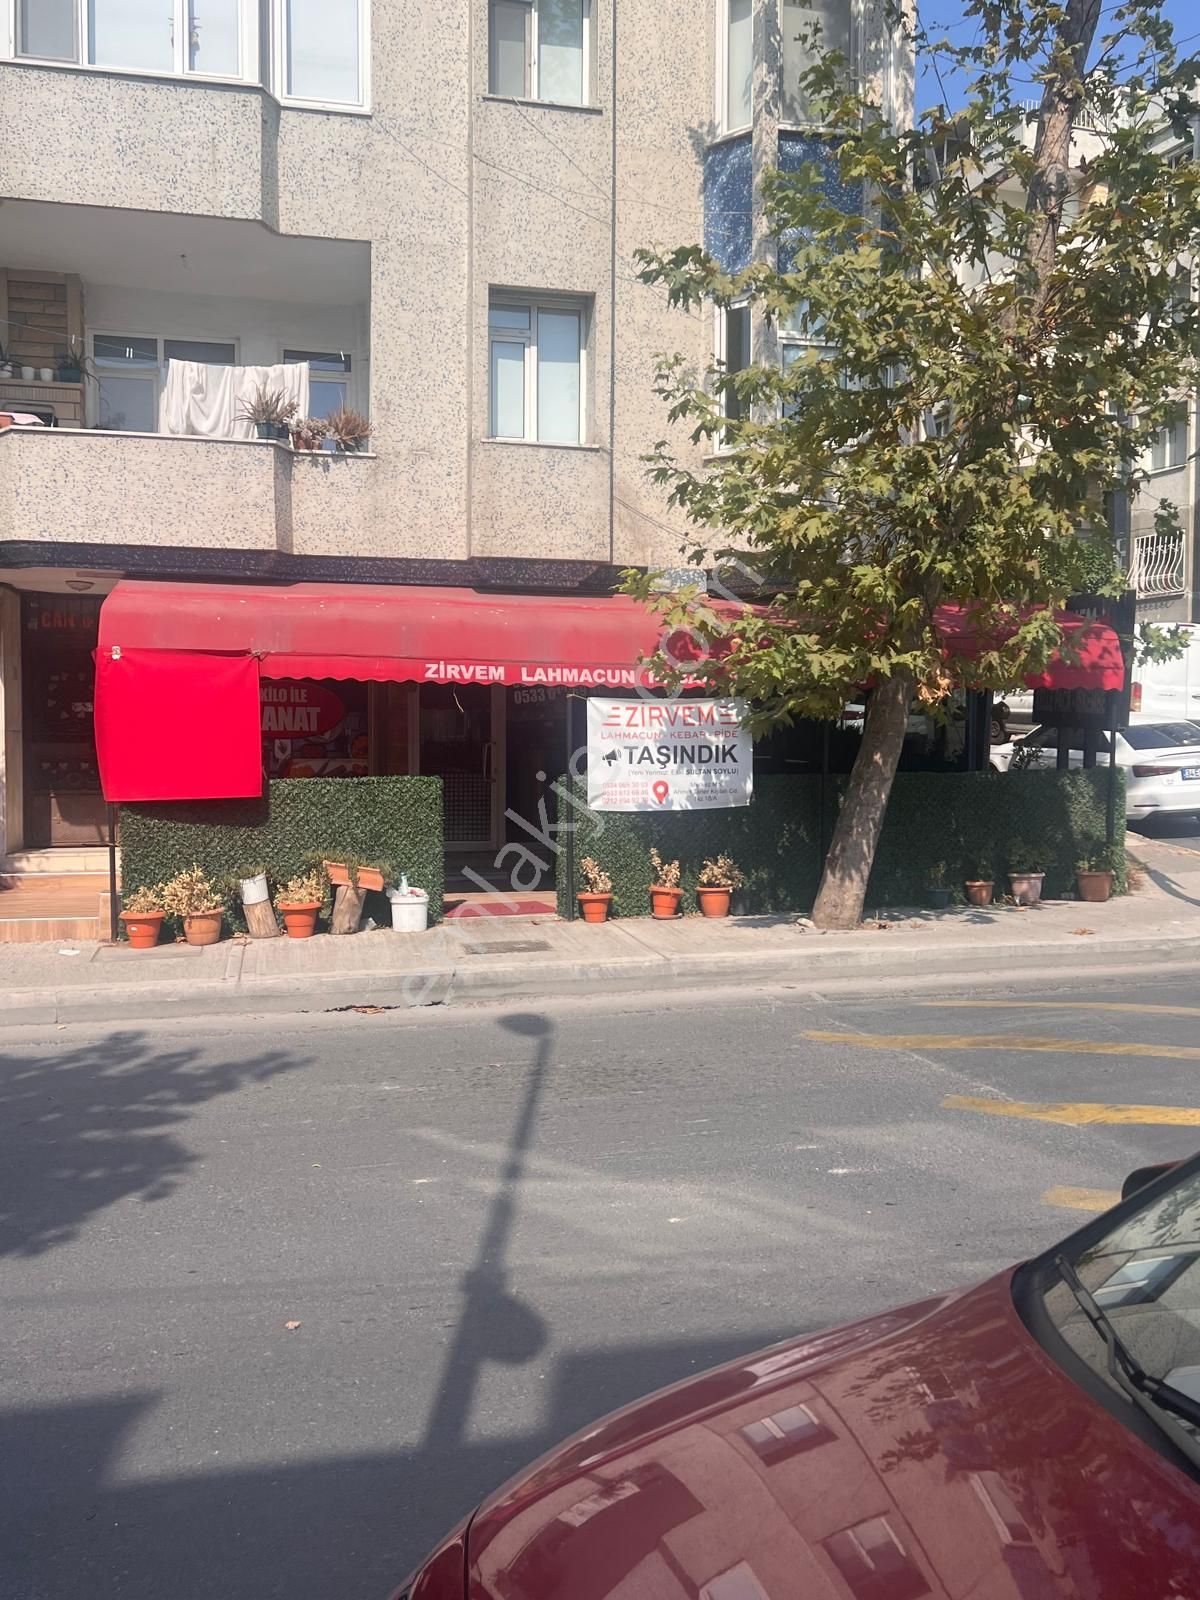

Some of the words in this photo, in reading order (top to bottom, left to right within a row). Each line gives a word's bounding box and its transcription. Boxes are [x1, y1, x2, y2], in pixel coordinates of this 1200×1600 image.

[425, 661, 505, 681] ZİRVEM
[521, 667, 635, 684] LAHMACUN
[290, 686, 307, 703] İLE
[261, 706, 320, 732] ANAT
[625, 702, 715, 727] ZİRVEM
[601, 731, 660, 740] LAHMACUN
[714, 728, 738, 738] PİDE
[624, 744, 739, 769] TAŞINDIK
